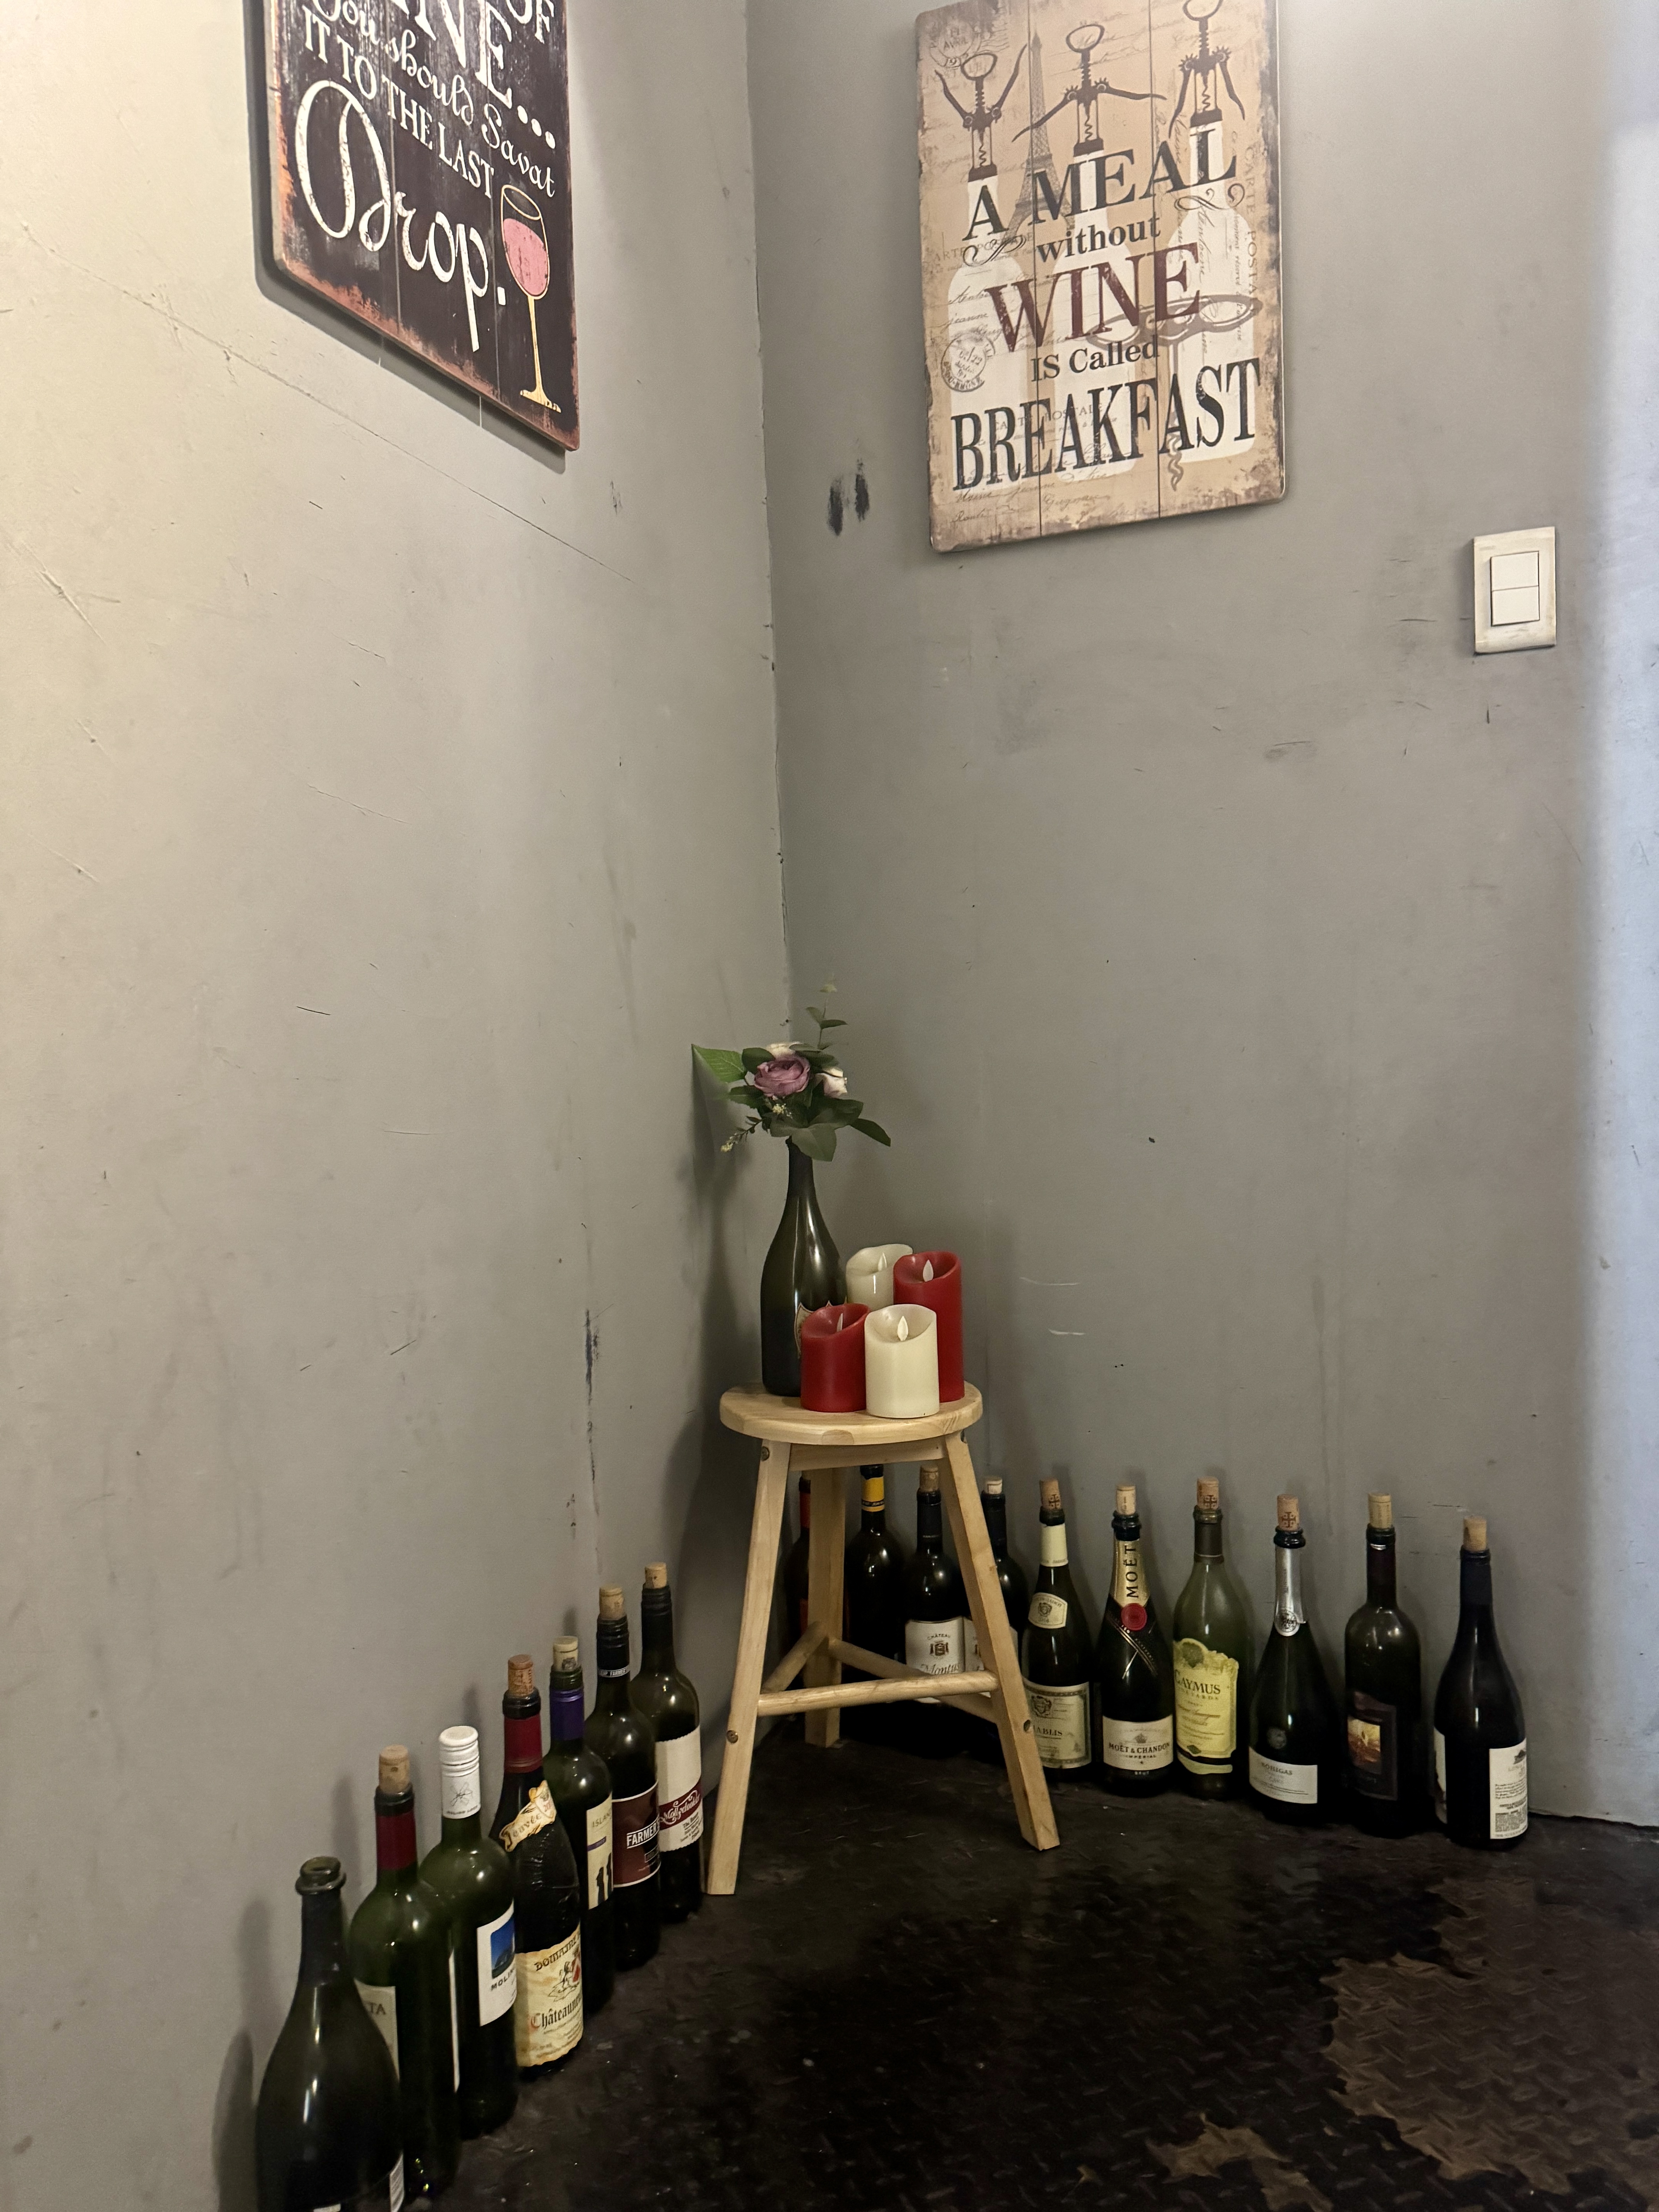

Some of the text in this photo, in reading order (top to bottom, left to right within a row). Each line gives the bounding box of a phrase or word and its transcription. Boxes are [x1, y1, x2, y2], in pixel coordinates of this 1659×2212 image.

[302, 5, 494, 199] IT TO THE LAST
[385, 29, 474, 125] should
[295, 80, 507, 352] Drop.
[962, 184, 1010, 242] A
[1027, 128, 1237, 226] MEAL
[1036, 214, 1161, 263] without
[984, 243, 1200, 353] WINE
[1031, 354, 1060, 383] IS
[1069, 334, 1161, 374] Called
[951, 357, 1260, 491] BREAKFAST
[1123, 1545, 1139, 1598] MOËT
[1175, 1669, 1221, 1695] CAYMUS
[1033, 1724, 1063, 1736] ABLIS
[1137, 1742, 1170, 1753] CHANDON
